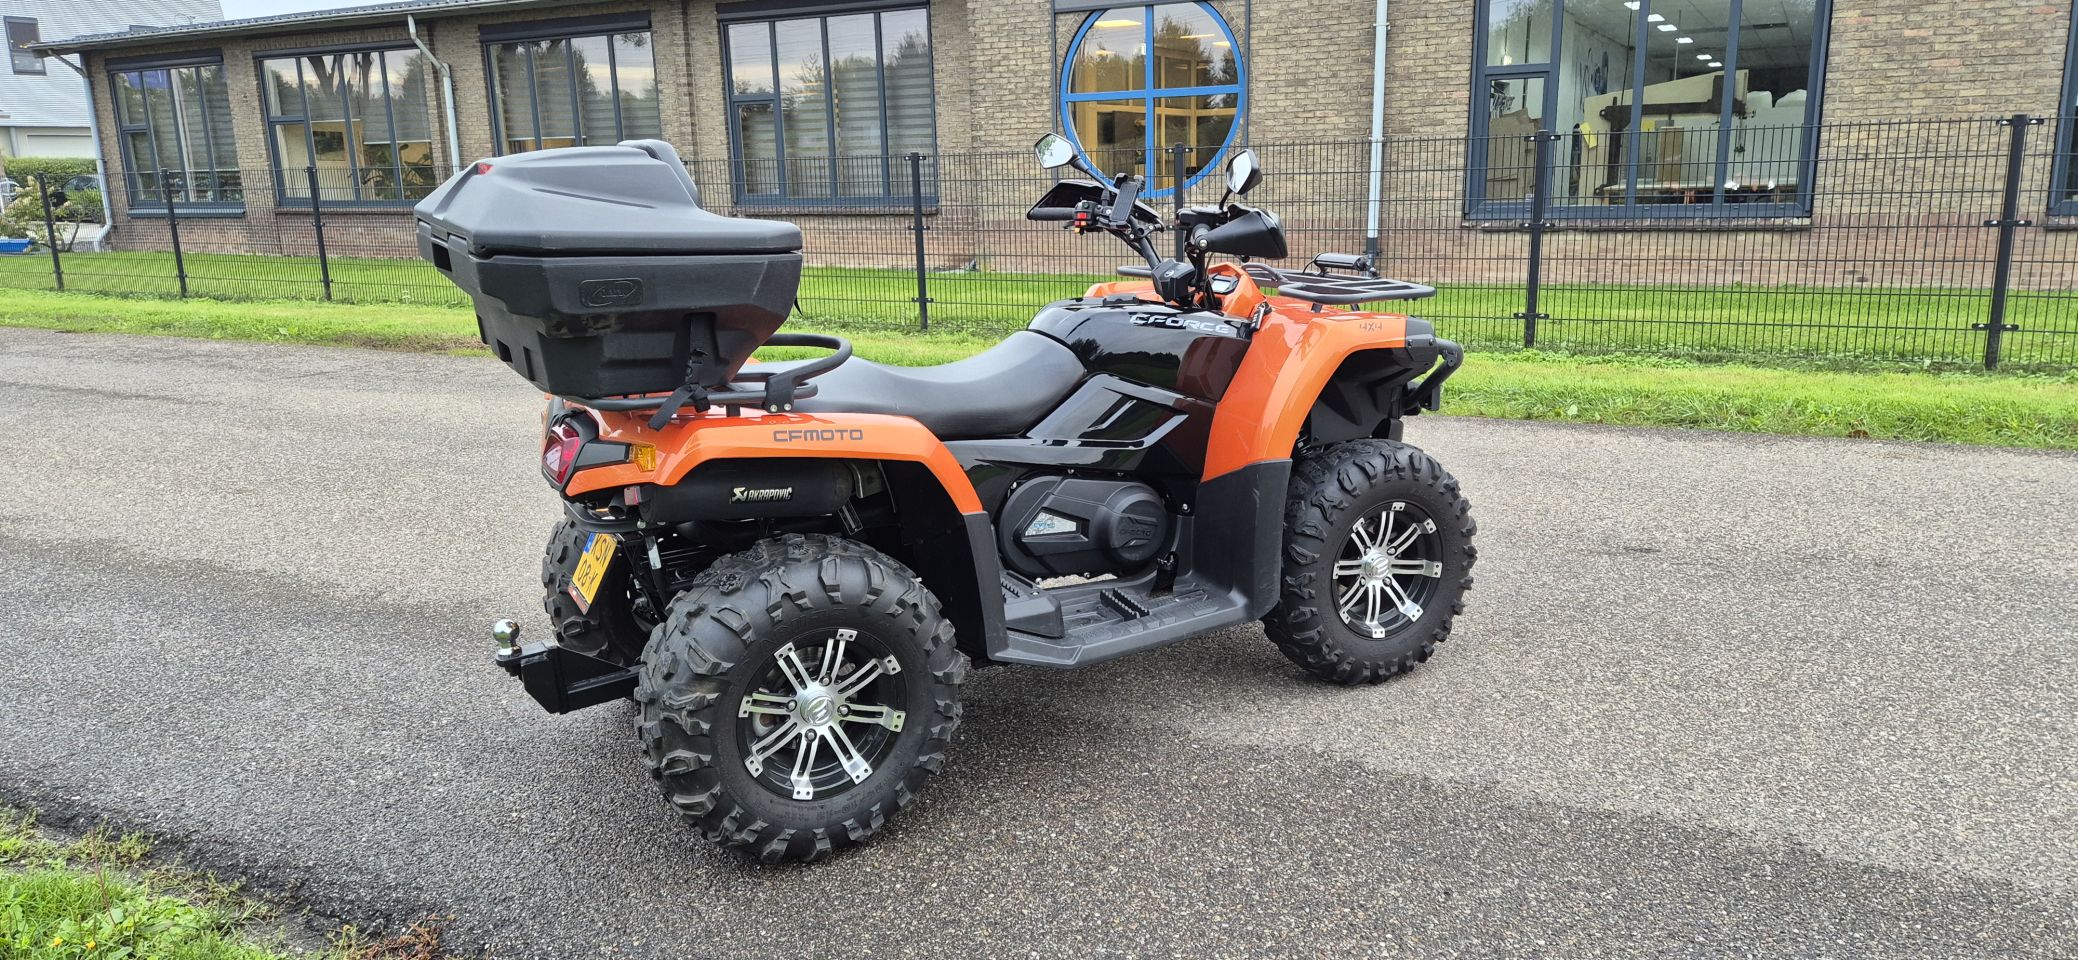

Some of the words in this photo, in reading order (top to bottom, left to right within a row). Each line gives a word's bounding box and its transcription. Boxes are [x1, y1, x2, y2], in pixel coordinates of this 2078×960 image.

[1129, 313, 1230, 334] CFORCE
[773, 429, 863, 442] CFMOTO
[591, 534, 612, 567] KSN
[577, 558, 599, 596] 08-K
